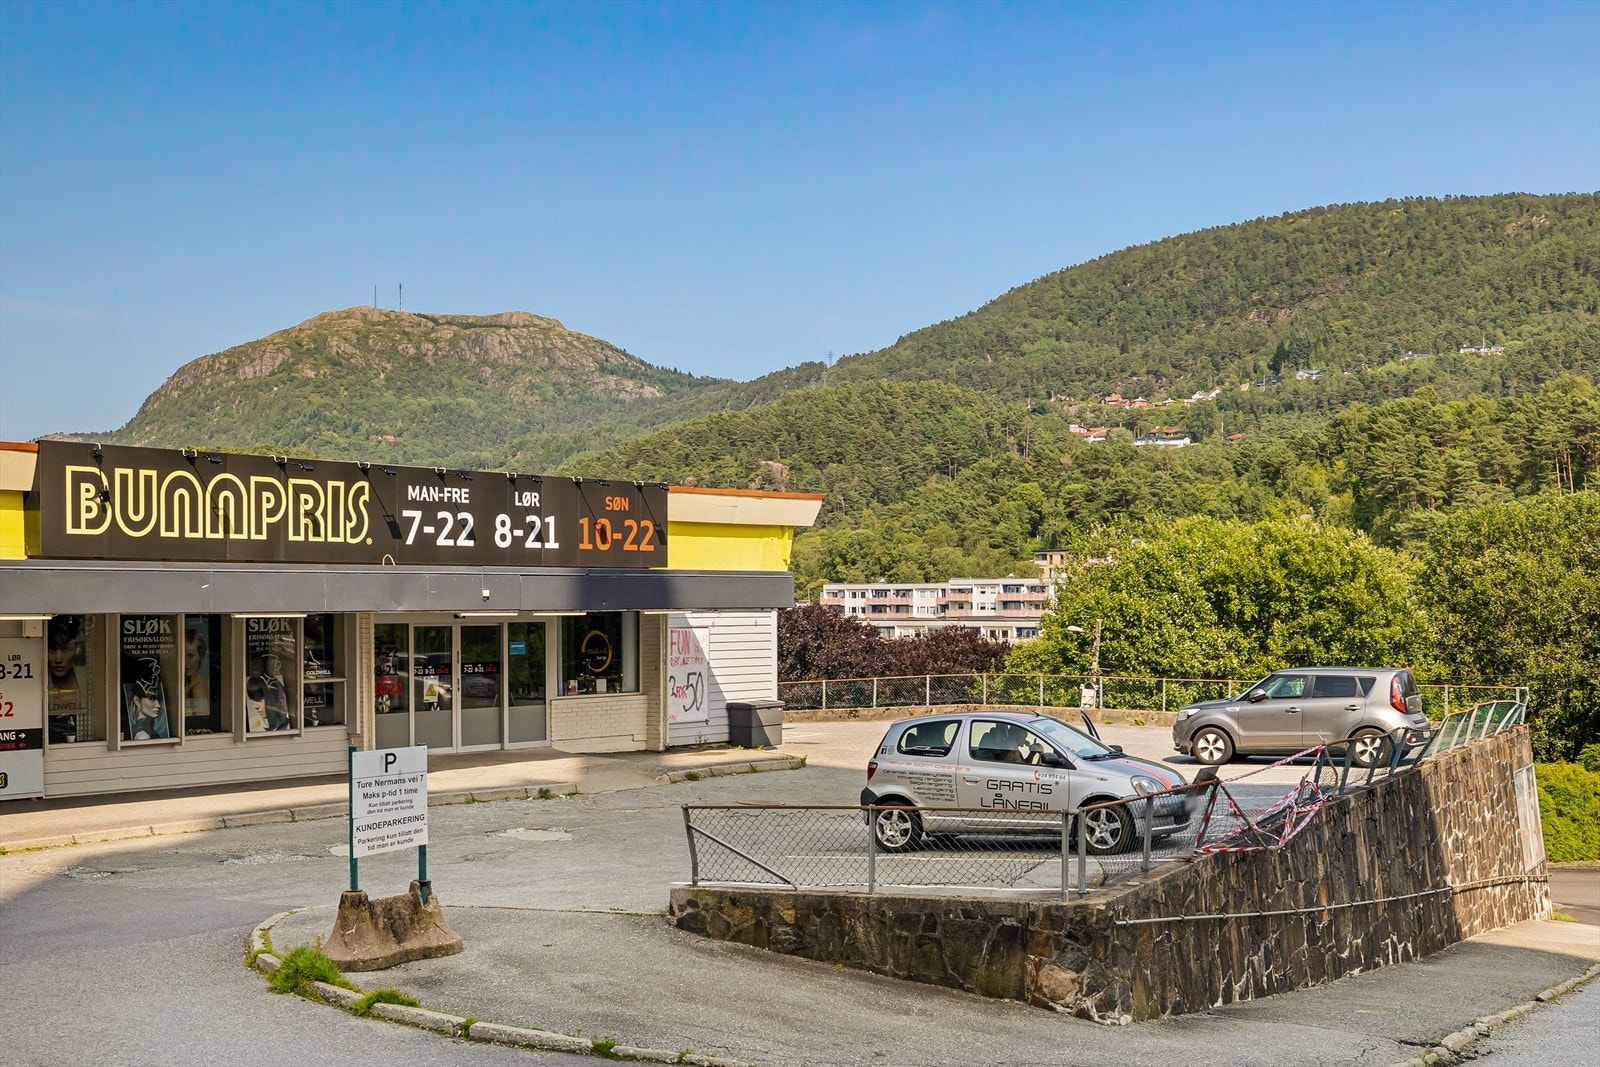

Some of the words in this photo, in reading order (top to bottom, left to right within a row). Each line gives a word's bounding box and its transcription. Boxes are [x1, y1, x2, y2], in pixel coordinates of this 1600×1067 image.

[66, 465, 370, 544] BUNNPRIS
[408, 485, 470, 504] MAN-FRE
[515, 492, 540, 507] LØR
[605, 496, 629, 512] SØN
[402, 510, 475, 546] 7-22
[494, 514, 560, 549] 8-21
[578, 516, 655, 551] 10-22
[124, 618, 171, 636] SLØK
[248, 618, 291, 633] SLØK
[683, 672, 704, 712] 50
[385, 752, 397, 773] P
[357, 780, 372, 789] Ture
[374, 777, 406, 786] Nermans
[986, 780, 1052, 794] GRATIS
[382, 790, 397, 799] p-tid
[356, 814, 425, 833] KUNDEPARKERING
[358, 834, 385, 845] Parkering
